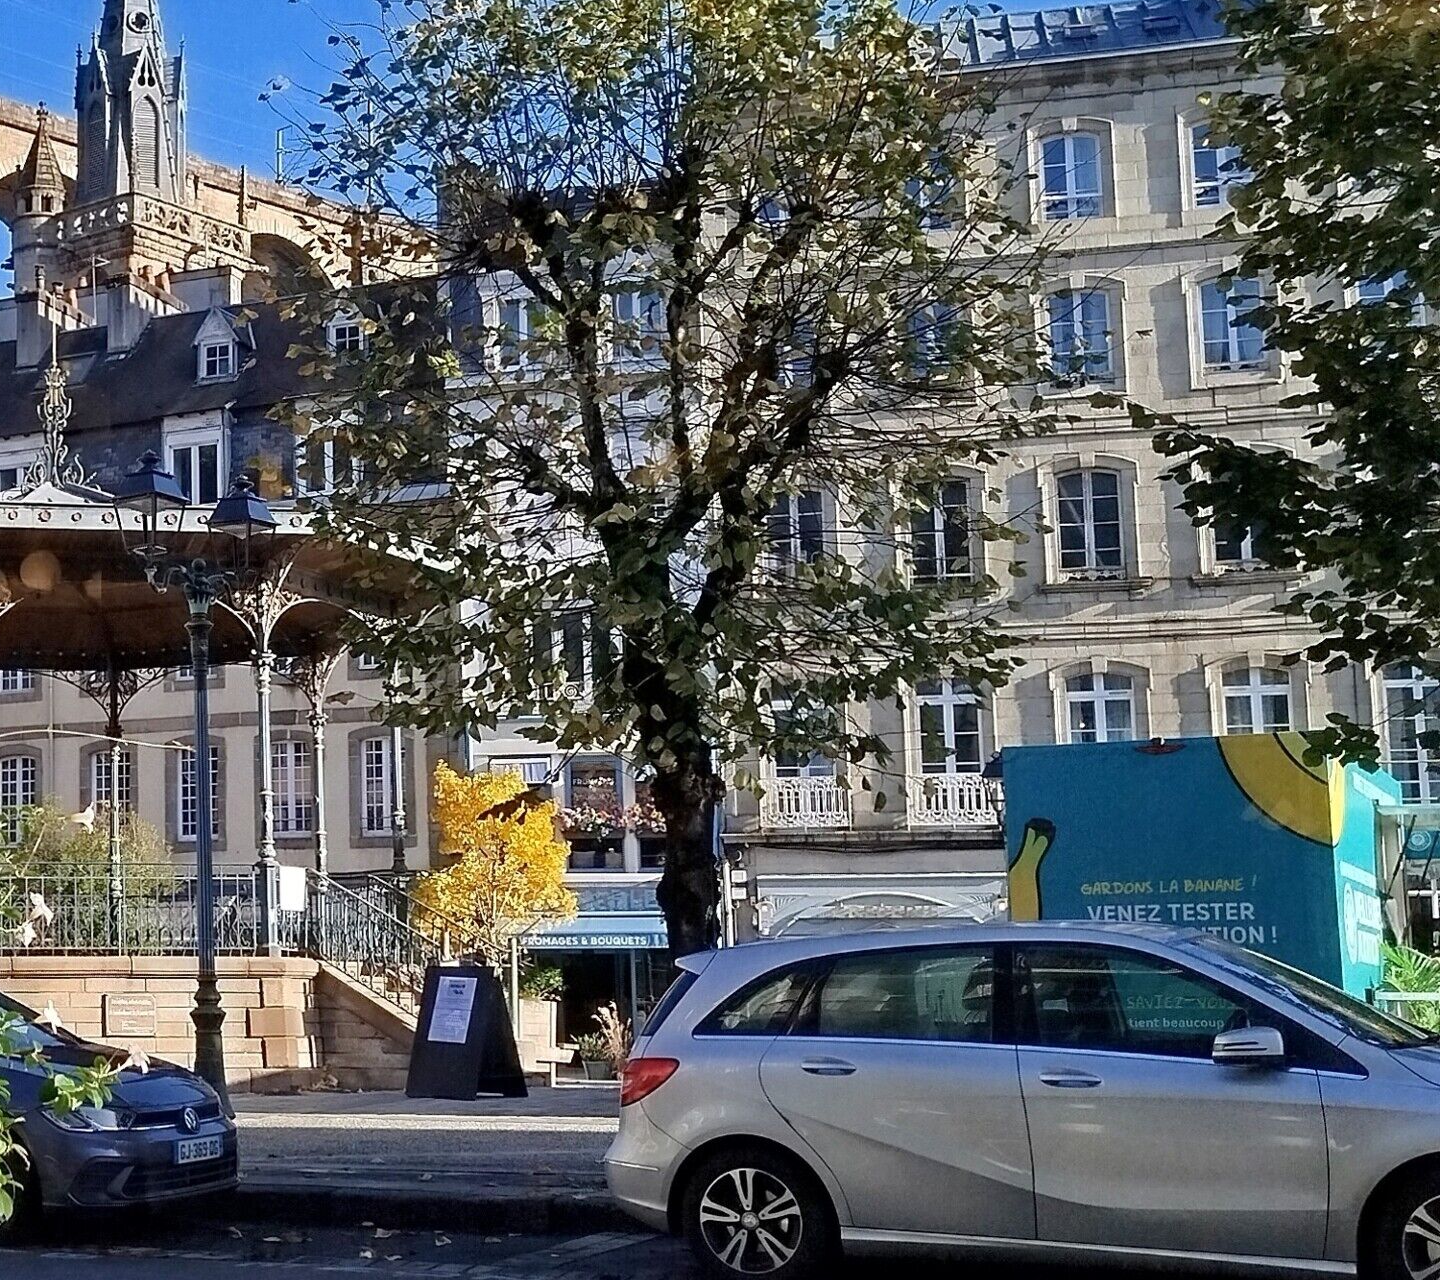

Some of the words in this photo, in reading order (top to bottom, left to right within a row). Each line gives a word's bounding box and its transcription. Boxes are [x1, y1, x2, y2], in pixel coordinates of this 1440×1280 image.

[1080, 880, 1153, 895] GARDONS
[1160, 880, 1179, 893] LA
[1184, 877, 1244, 893] BANANE
[1087, 904, 1160, 922] VENEZ
[1167, 902, 1255, 921] TESTER
[520, 935, 578, 946] FROMAGES
[581, 936, 588, 946] &
[591, 935, 647, 946] BOUQUETS
[1163, 1017, 1225, 1031] beaucoup
